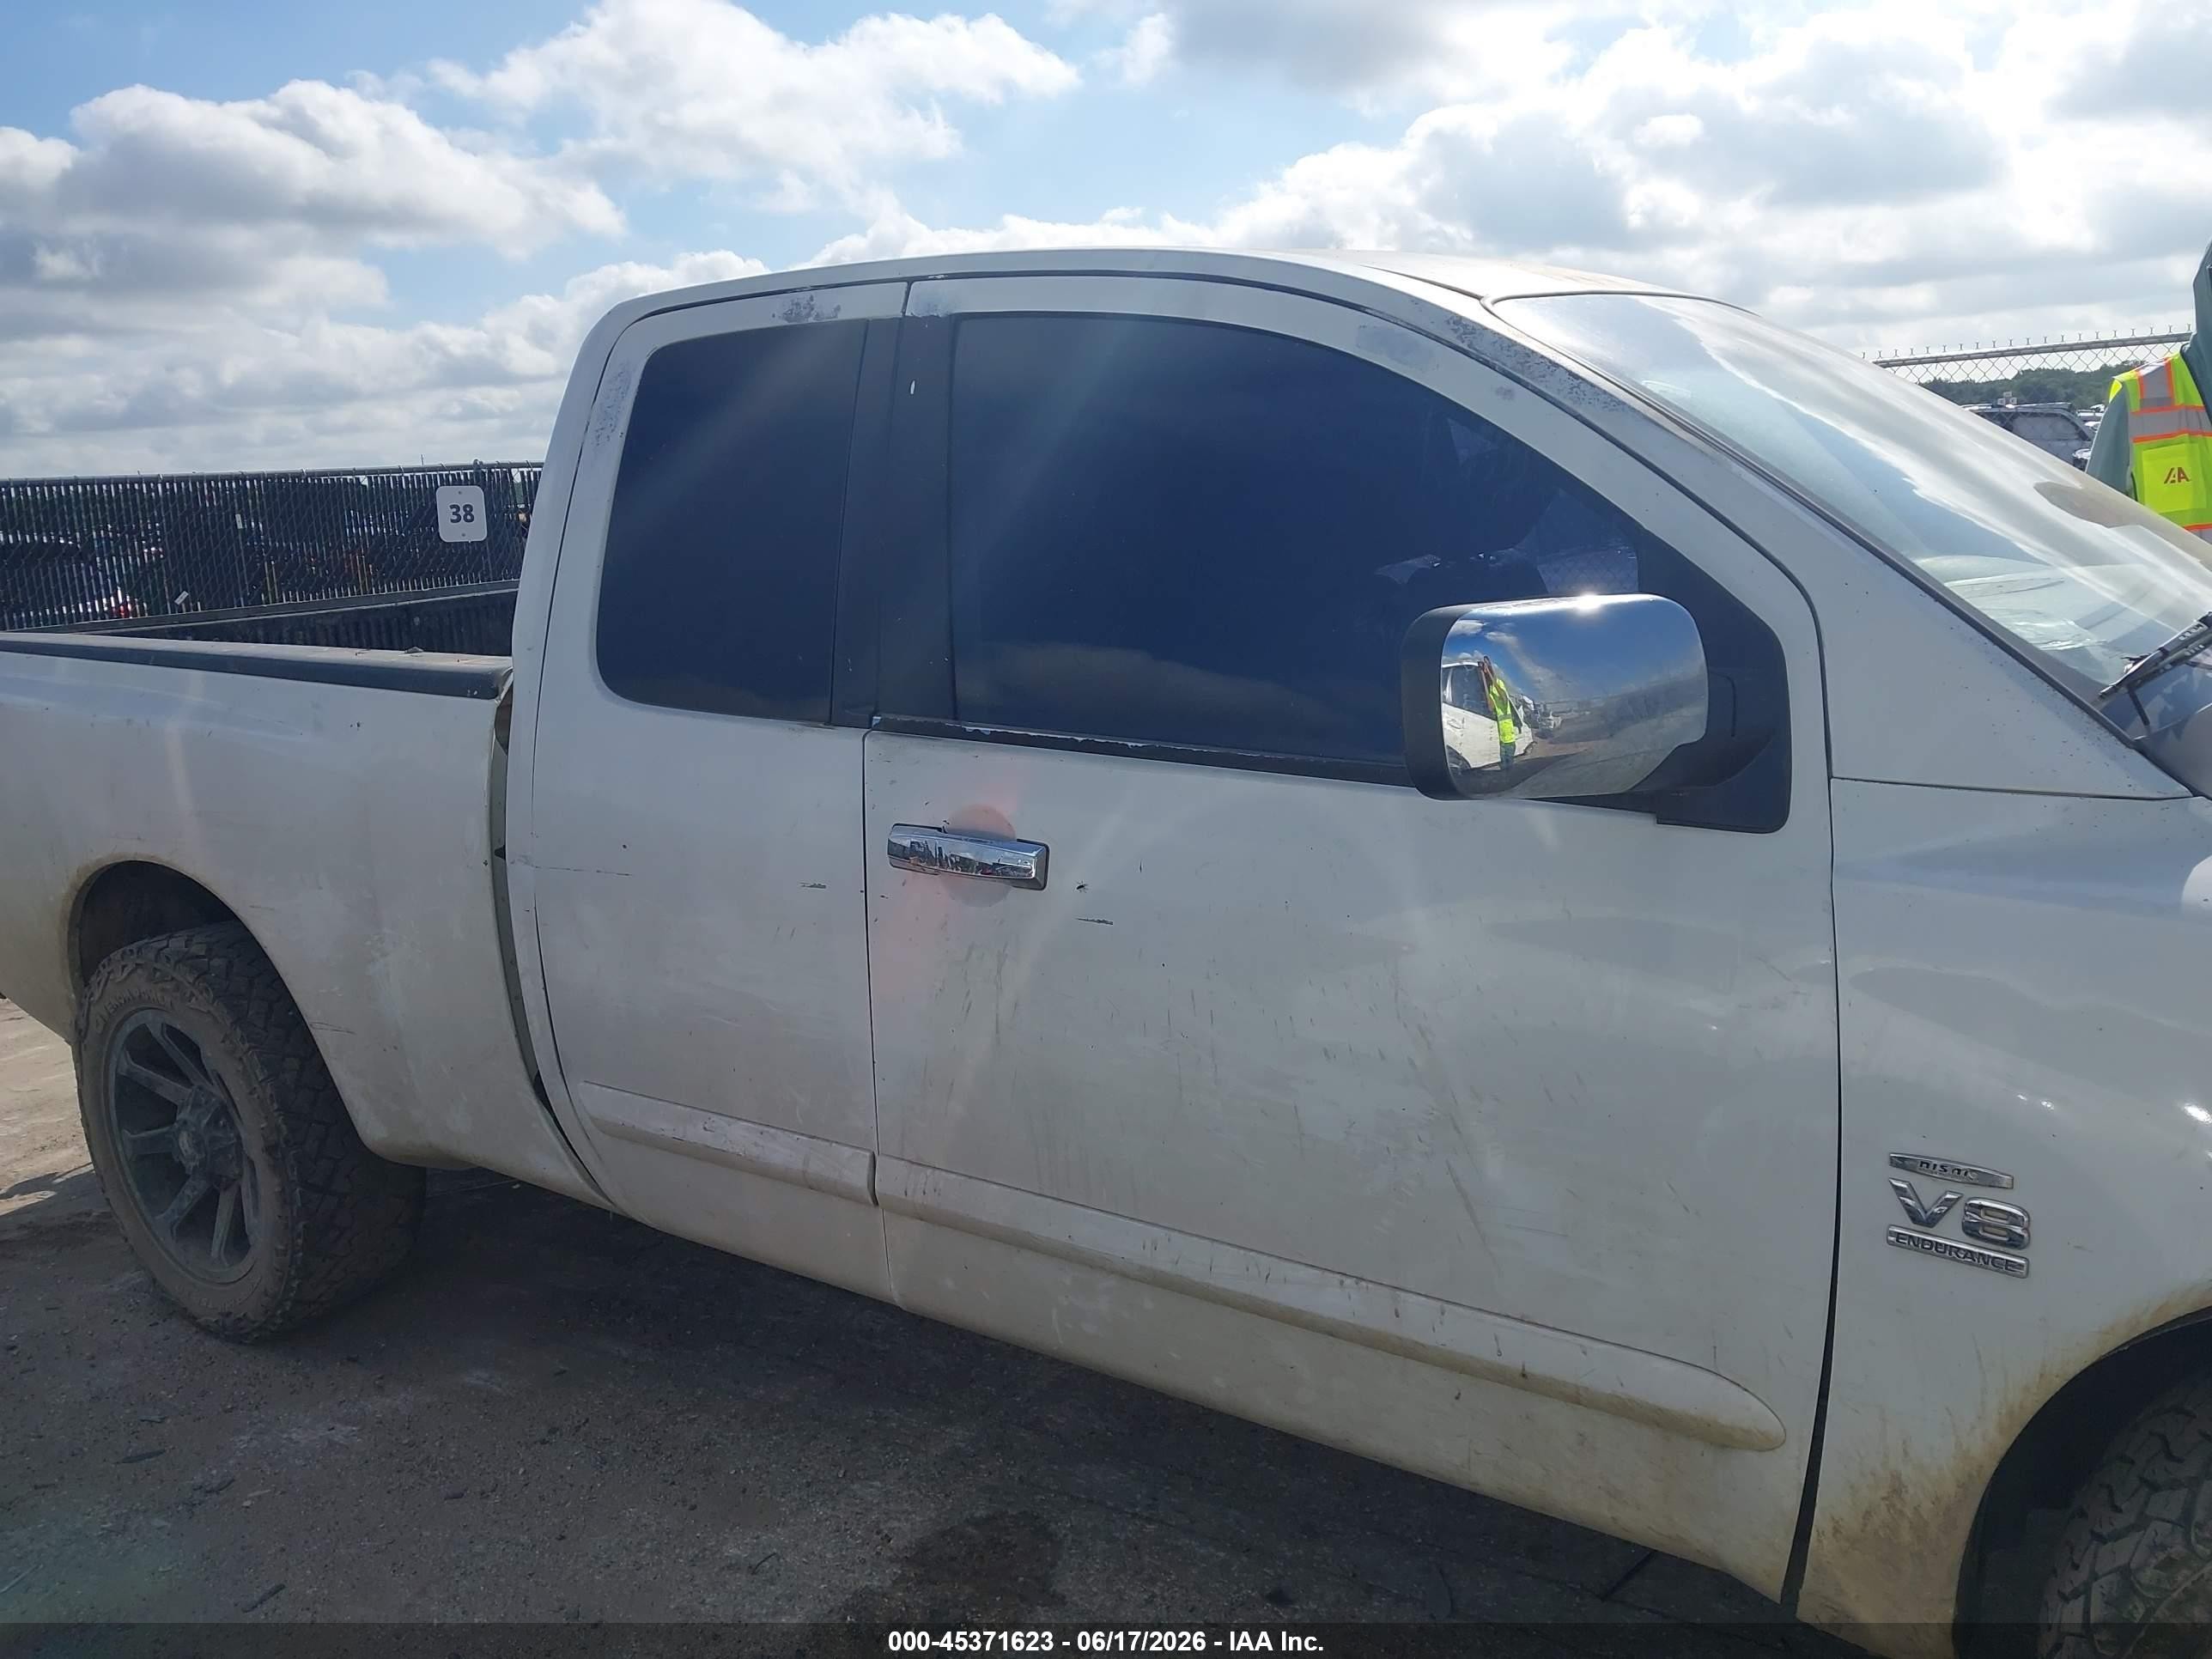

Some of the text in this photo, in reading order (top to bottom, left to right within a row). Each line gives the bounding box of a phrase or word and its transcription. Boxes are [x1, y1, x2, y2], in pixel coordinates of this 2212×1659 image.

[449, 503, 475, 524] 38
[1888, 1177, 2030, 1249] V8
[1895, 1232, 2024, 1273] ENDURANCE
